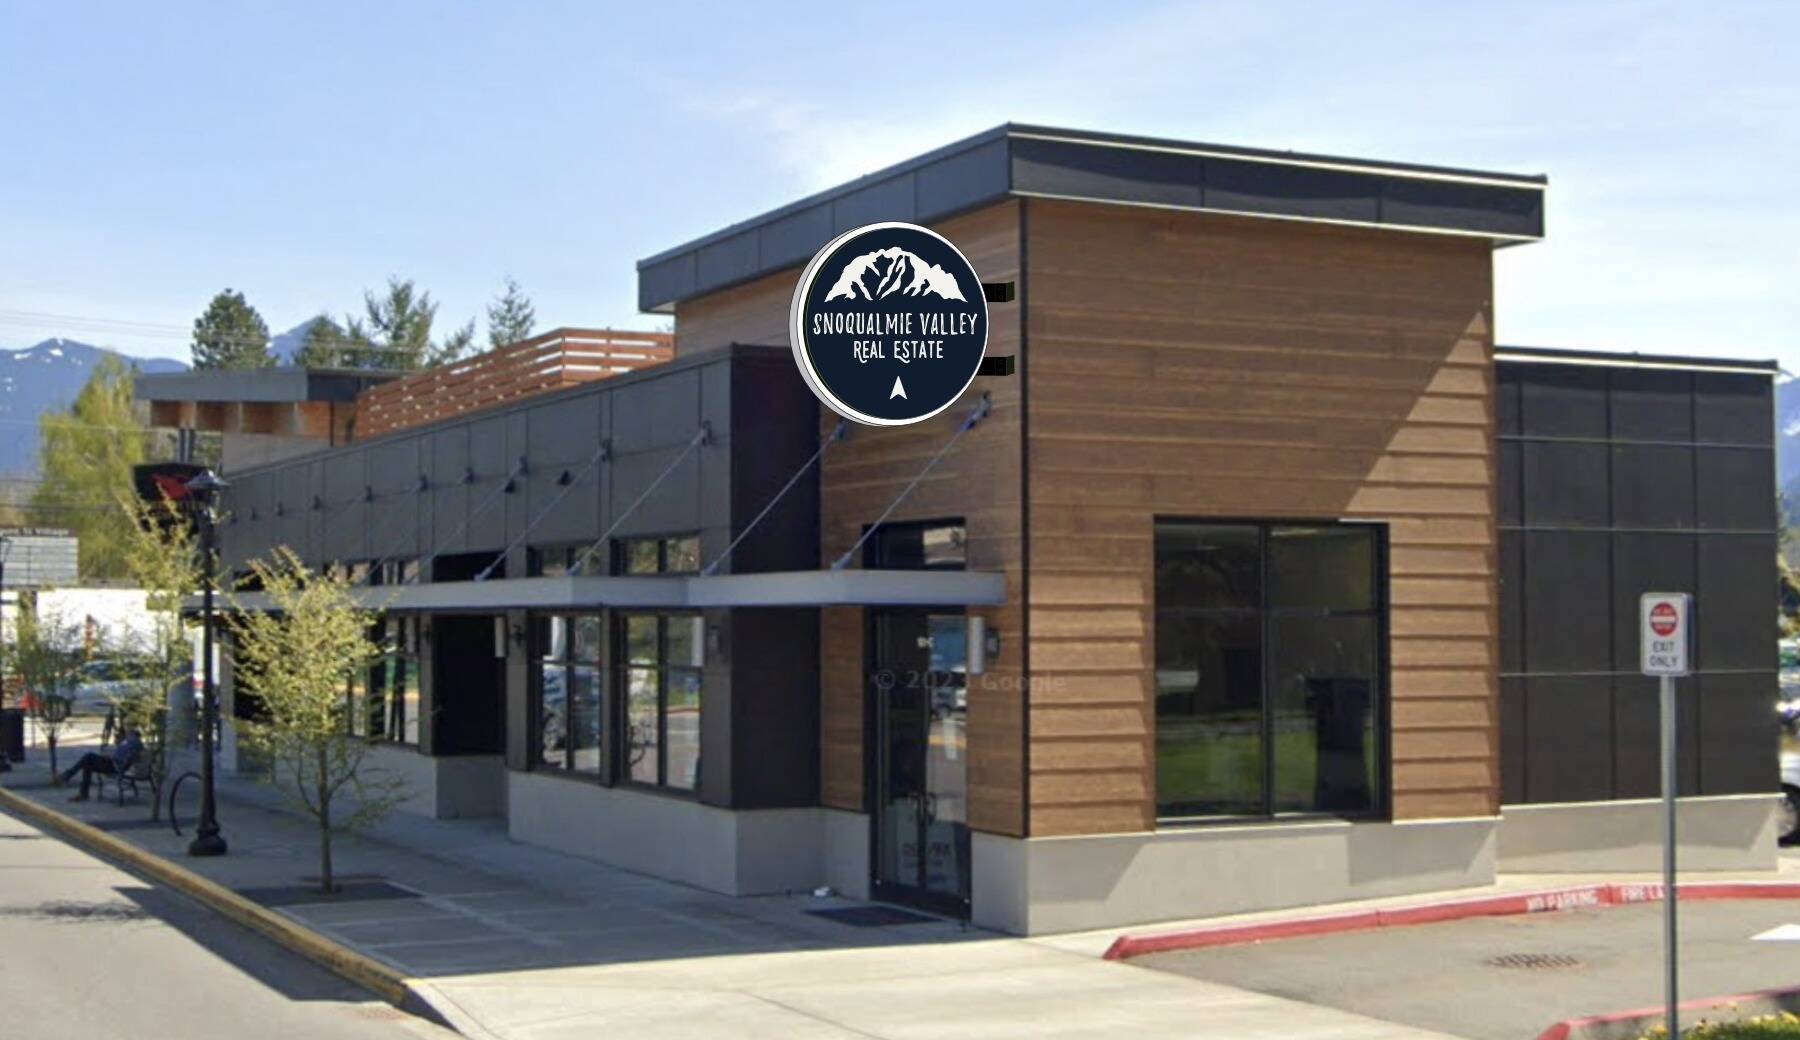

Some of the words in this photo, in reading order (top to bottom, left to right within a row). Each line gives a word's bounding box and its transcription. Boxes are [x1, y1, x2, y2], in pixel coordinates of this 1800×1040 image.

[813, 312, 912, 335] SNOQUALMIE
[920, 312, 978, 335] VALLEY
[853, 341, 885, 363] REAL
[894, 341, 944, 363] ESTATE
[1653, 640, 1675, 652] EXIT
[1649, 655, 1678, 667] ONLY
